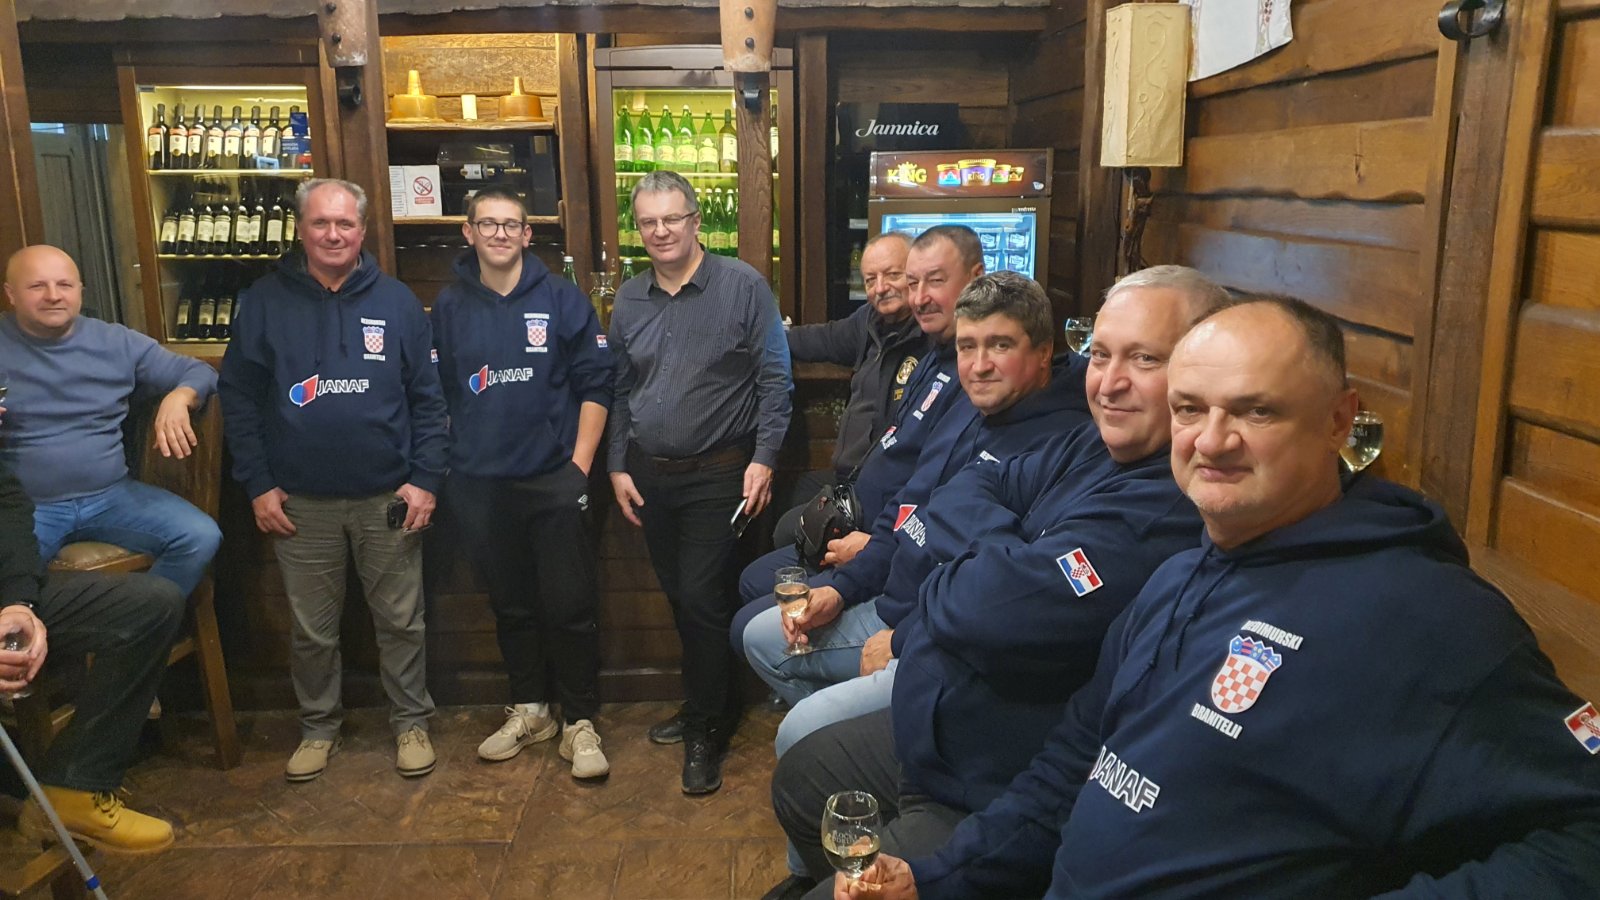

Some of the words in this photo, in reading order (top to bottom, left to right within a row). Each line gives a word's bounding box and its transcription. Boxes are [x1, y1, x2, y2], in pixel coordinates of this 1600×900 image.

[855, 119, 939, 138] Jamnica
[487, 367, 533, 386] JANAF
[317, 379, 369, 396] JANAF
